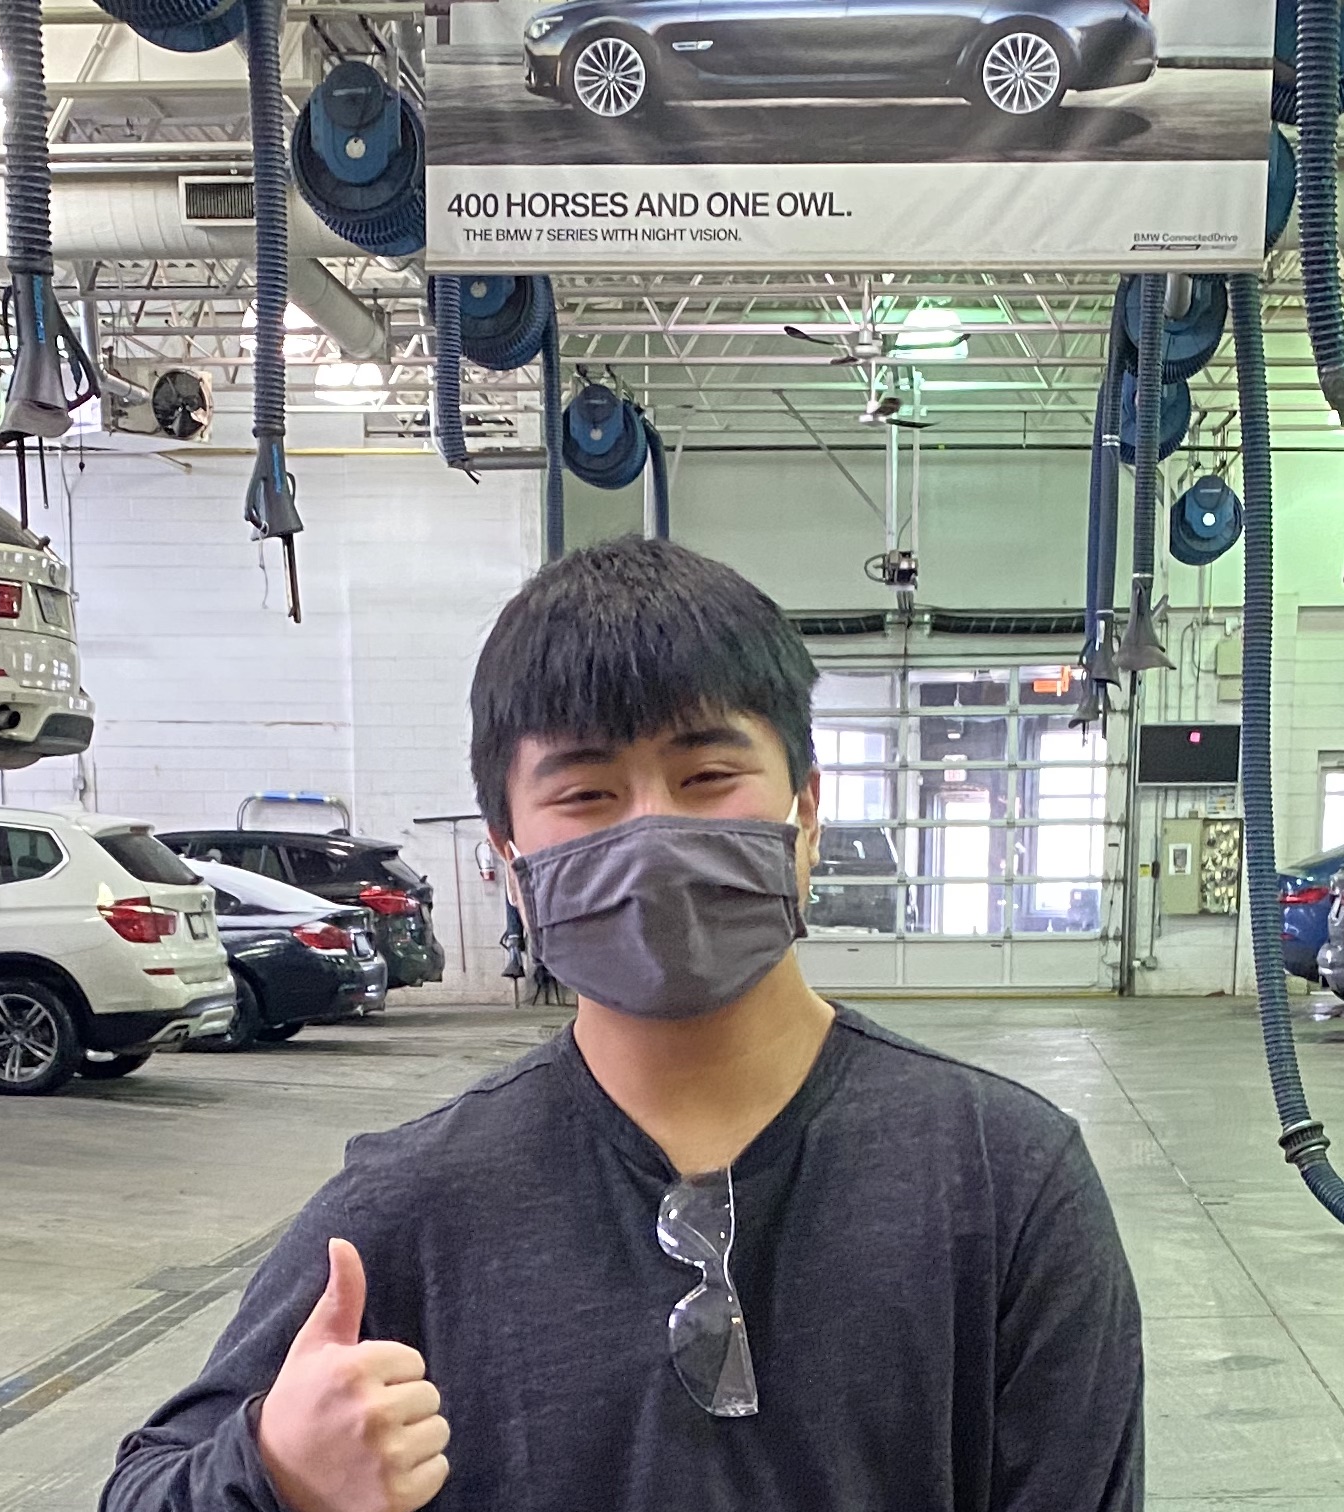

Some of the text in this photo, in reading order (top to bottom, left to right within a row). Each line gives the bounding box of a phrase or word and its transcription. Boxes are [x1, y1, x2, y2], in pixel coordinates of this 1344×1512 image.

[447, 191, 853, 218] 400 HORSES AND ONE OWL.
[463, 228, 742, 242] THE BMW 7 SERIES WITH NIGHT VISION.
[1133, 232, 1239, 242] BMW ConnectedDrive
